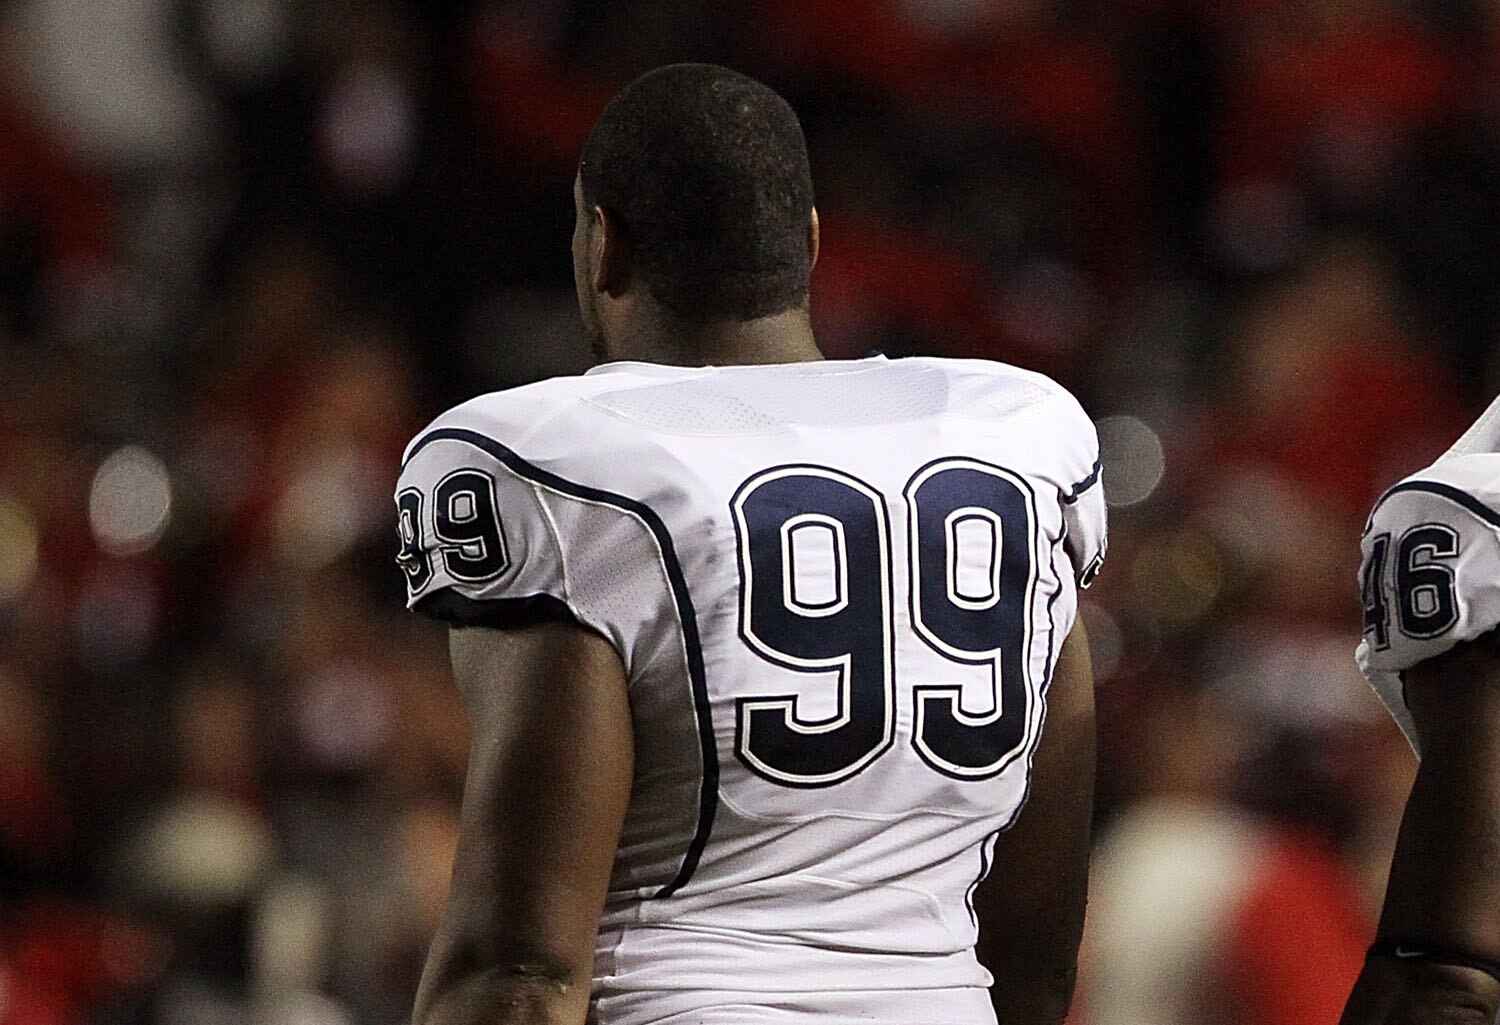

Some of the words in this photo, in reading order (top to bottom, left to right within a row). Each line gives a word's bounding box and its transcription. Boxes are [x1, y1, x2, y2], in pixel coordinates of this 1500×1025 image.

[397, 468, 512, 596] 99
[1361, 522, 1459, 652] 46
[730, 457, 1037, 789] 99
